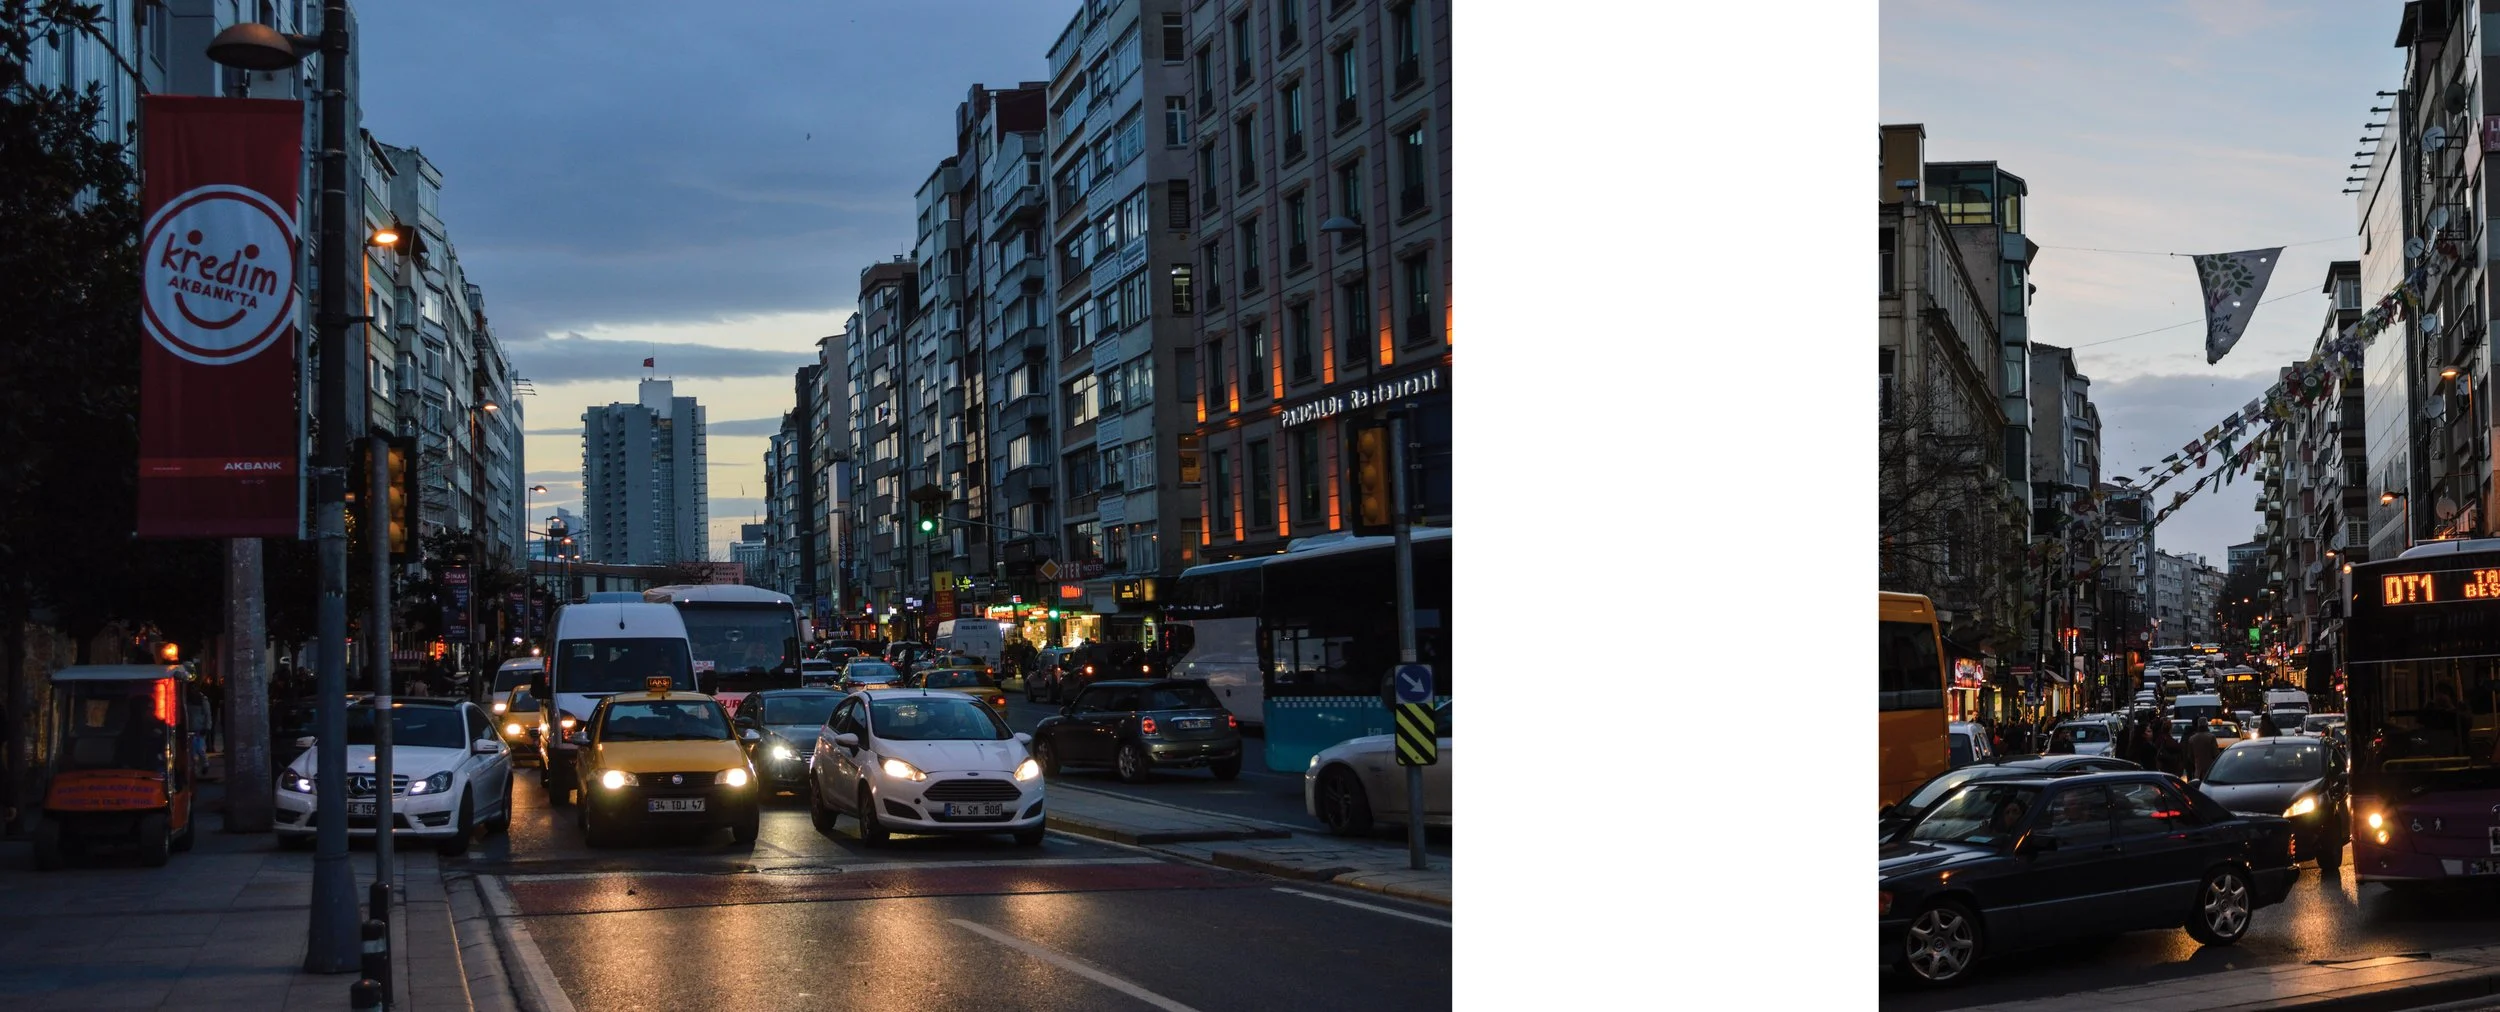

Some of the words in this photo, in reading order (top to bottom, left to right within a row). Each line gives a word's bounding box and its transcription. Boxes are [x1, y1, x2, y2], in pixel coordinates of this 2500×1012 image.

[161, 231, 277, 296] kredim
[168, 276, 258, 309] AKBANK'TA
[1351, 368, 1437, 409] Restaurant
[224, 461, 282, 471] AKBANK
[1055, 562, 1080, 580] OTER
[2384, 573, 2433, 604] DT1
[2473, 569, 2500, 583] TA
[655, 800, 665, 810] 34
[692, 800, 703, 810] 47
[951, 805, 961, 815] 34
[967, 805, 979, 815] SM
